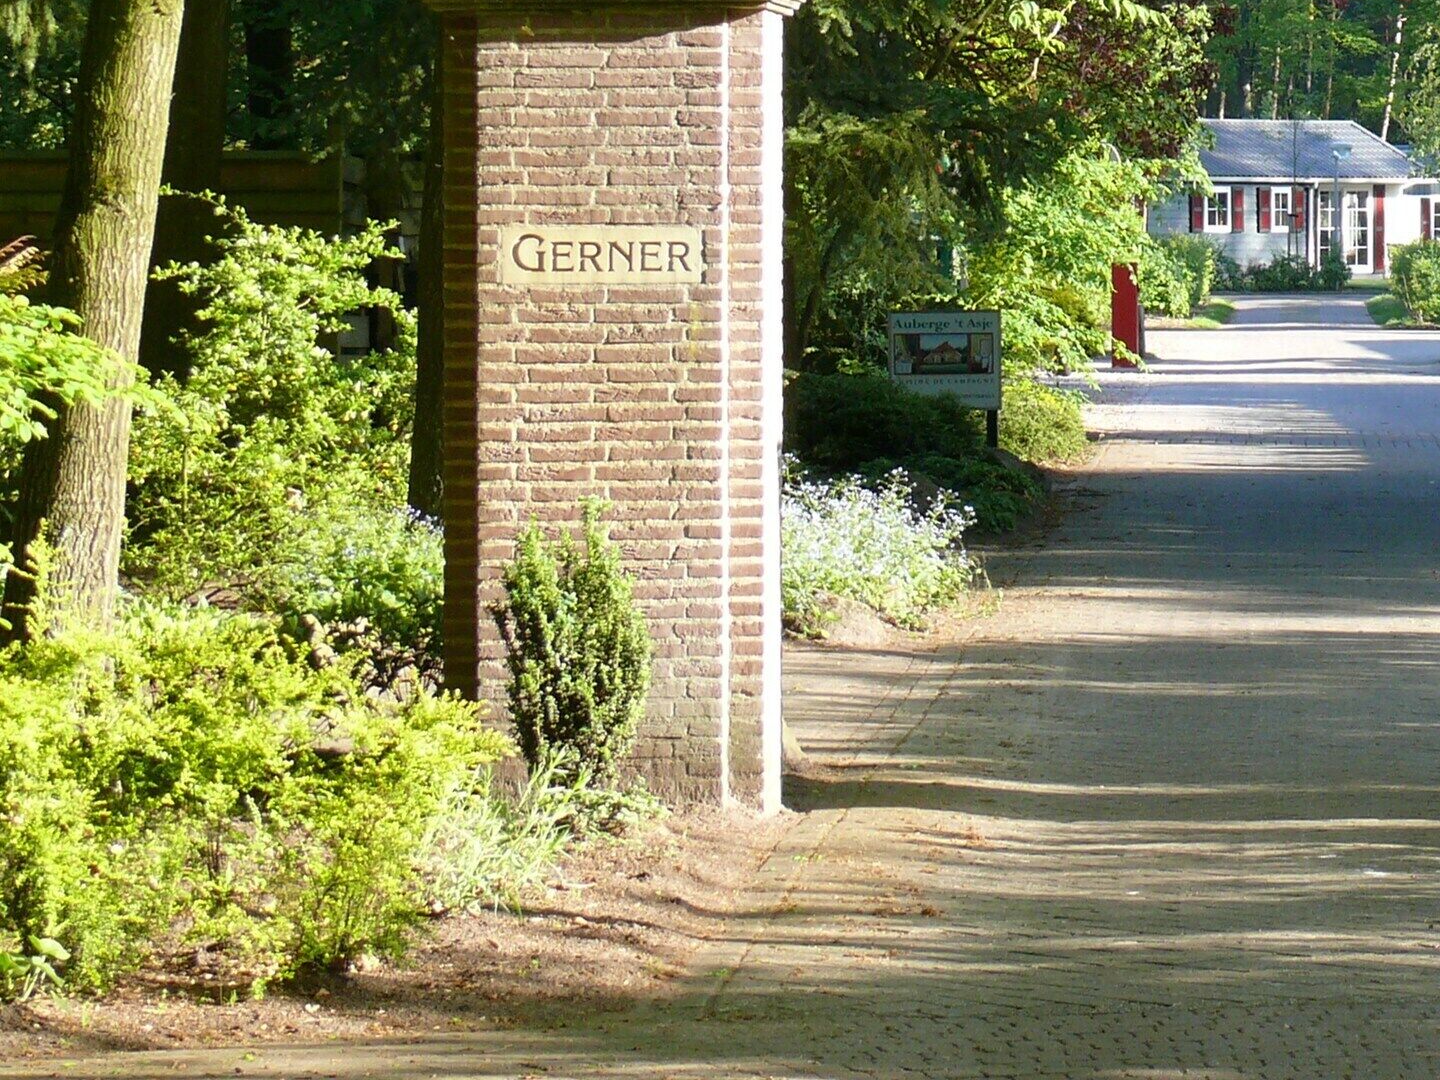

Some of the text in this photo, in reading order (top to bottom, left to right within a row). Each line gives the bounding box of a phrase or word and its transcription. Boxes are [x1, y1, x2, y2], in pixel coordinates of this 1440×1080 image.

[512, 233, 692, 273] GERNER
[893, 318, 993, 332] Auberge 't Asje
